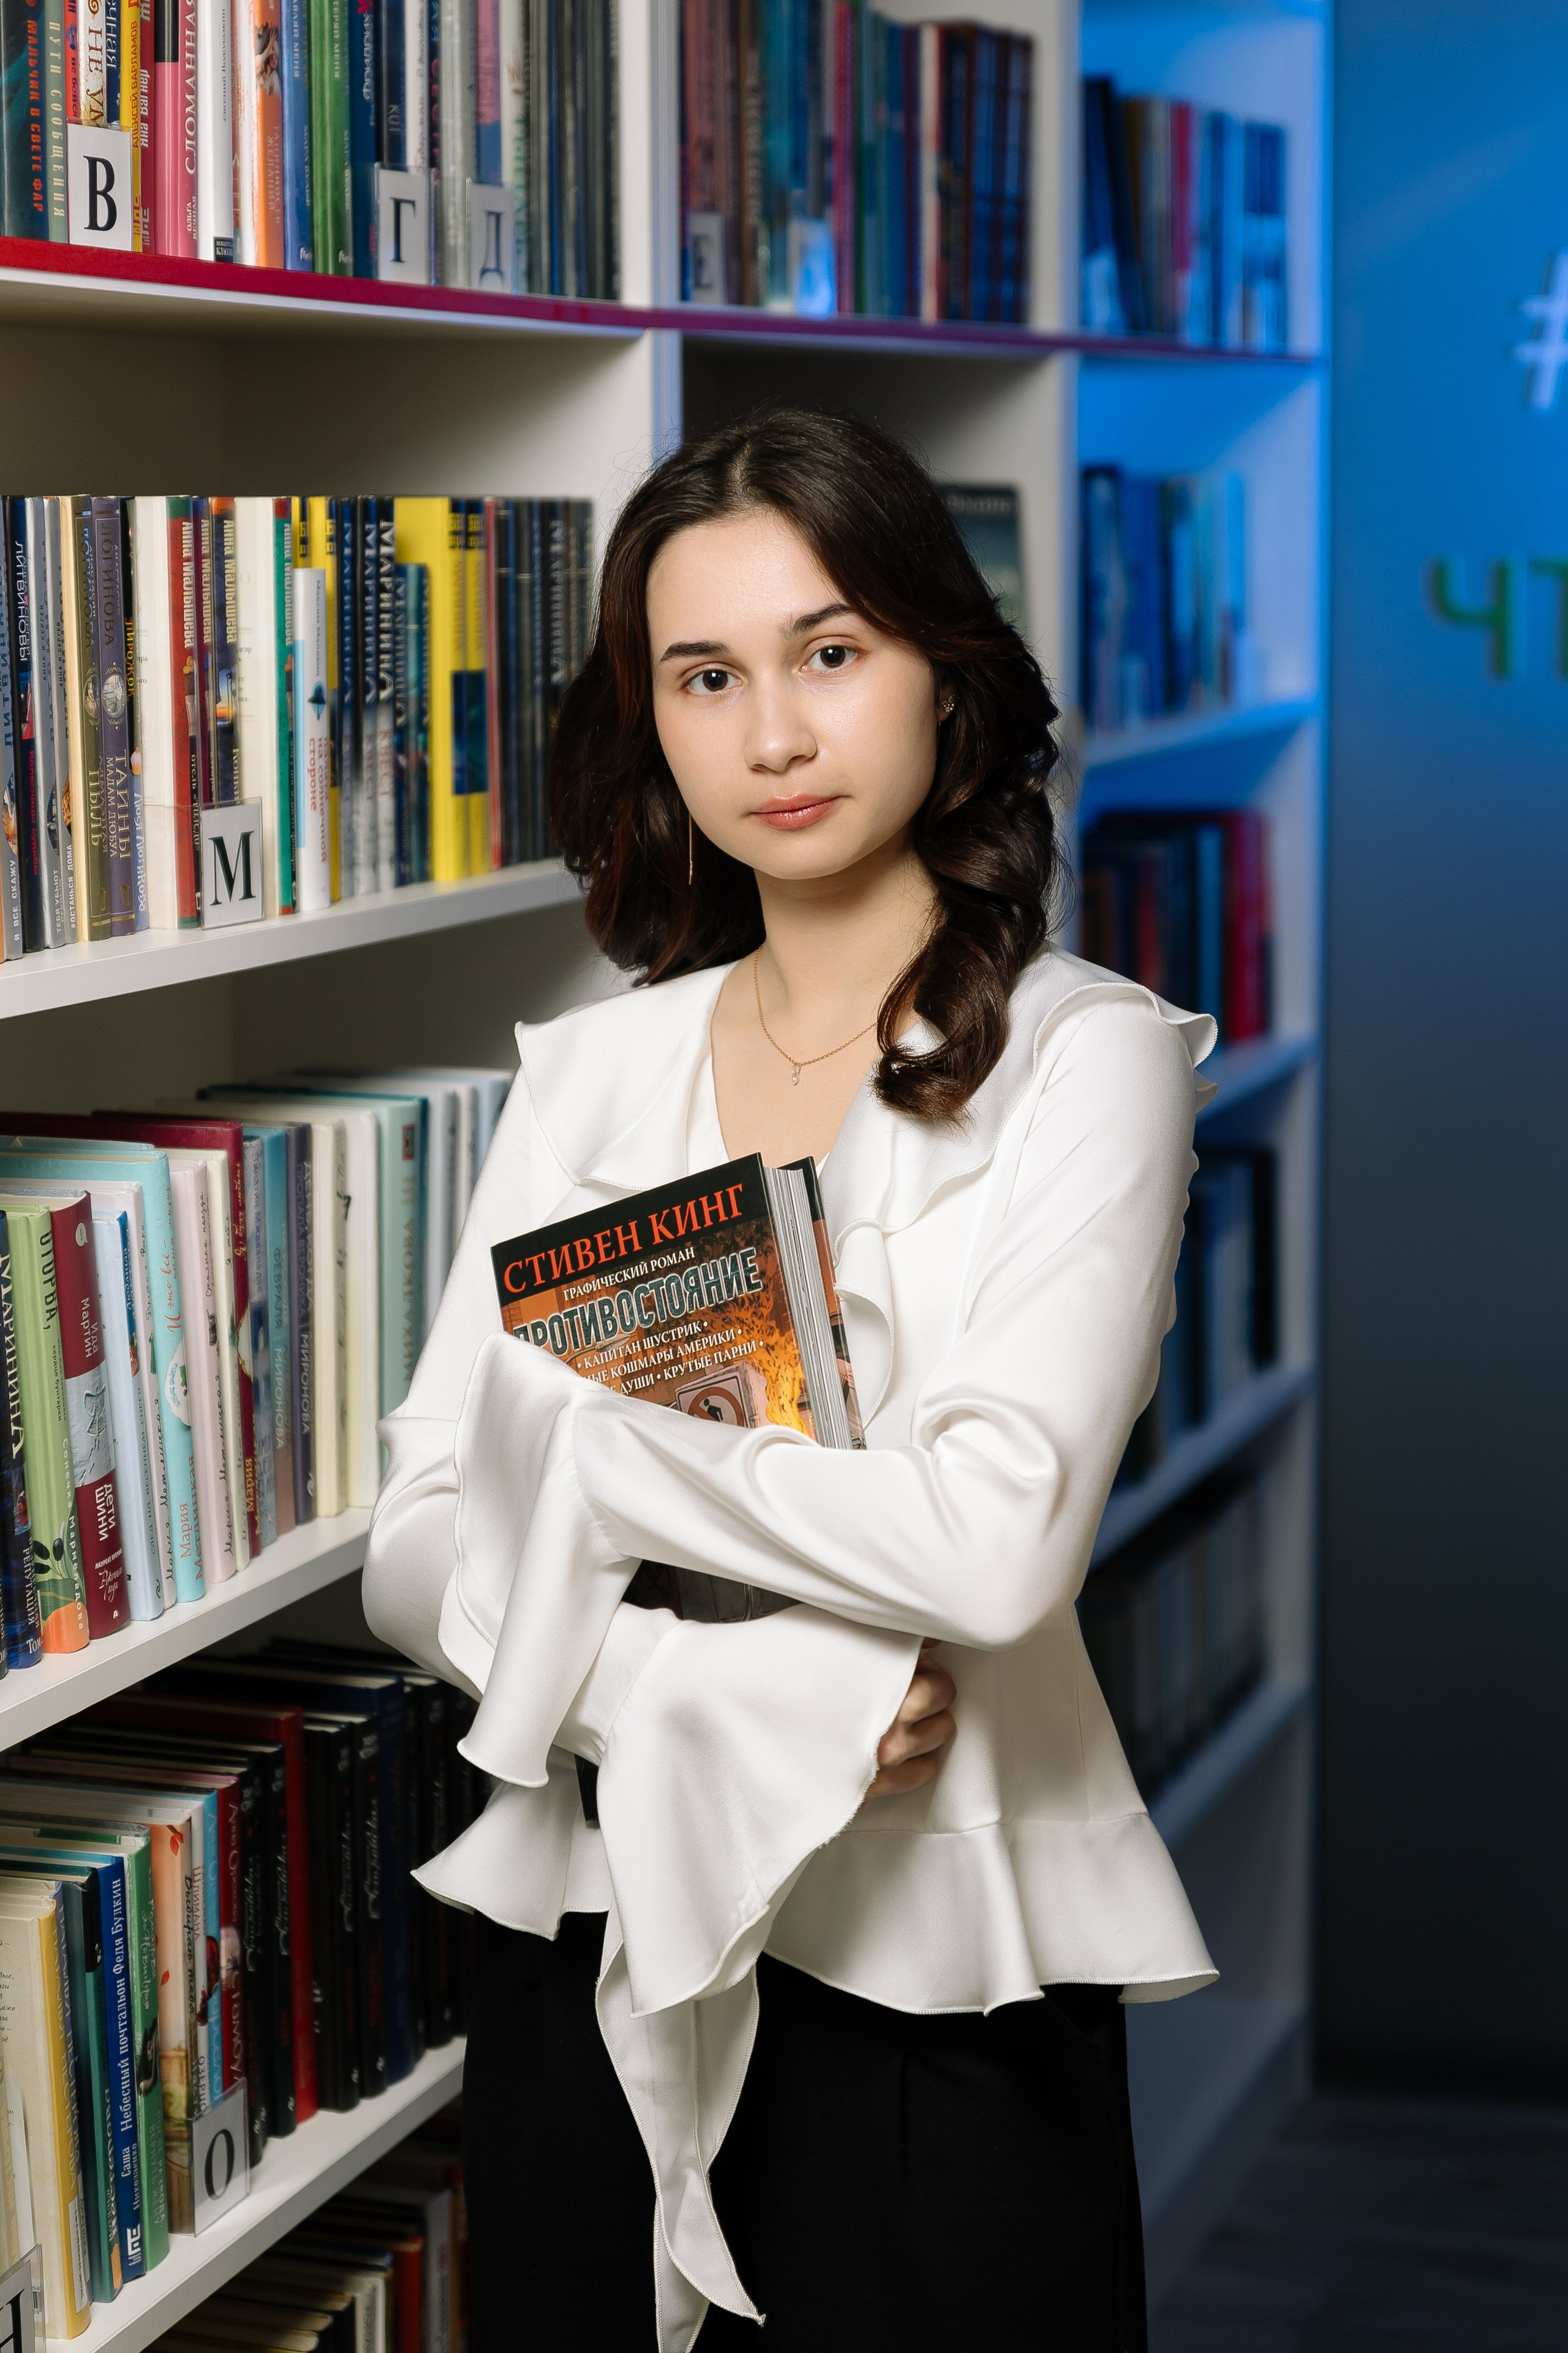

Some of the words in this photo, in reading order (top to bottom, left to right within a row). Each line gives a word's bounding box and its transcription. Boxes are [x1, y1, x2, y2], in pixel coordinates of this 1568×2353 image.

[27, 19, 40, 101] МАЛЬЧИК
[48, 21, 62, 74] ПУТИ
[88, 26, 104, 74] НЕ
[31, 107, 41, 117] В
[129, 94, 139, 148] АЛЕКСЕЙ
[140, 69, 151, 116] Вагнер
[31, 123, 42, 172] СВЕТЕ
[50, 89, 66, 217] СООБЩЕНИЯ
[32, 178, 43, 212] ФАР
[83, 156, 117, 232] В
[390, 197, 416, 263] Г
[479, 210, 503, 290] Д
[182, 521, 194, 558] Анна
[201, 519, 210, 555] Анна
[224, 519, 235, 556] Анна
[15, 540, 28, 661] ЛИТВИНОВЫ
[101, 523, 116, 648] ЛОГИНОВА
[183, 561, 195, 649] Малышева
[202, 557, 212, 644] Малышева
[224, 558, 237, 644] Малышева
[364, 523, 377, 704] МАРИНИНА
[379, 519, 394, 702] МАРИНИНА
[106, 757, 115, 807] МАДАМ
[307, 737, 317, 811] стороне
[88, 769, 102, 846] ПЫЛЬ
[108, 810, 117, 858] ДЮБУА
[134, 792, 143, 831] Люся
[136, 835, 146, 912] Лютикова
[208, 830, 256, 907] М
[13, 933, 20, 942] Я
[200, 1192, 209, 1233] поезда
[503, 1220, 643, 1294] СТИВЕН
[648, 1183, 743, 1245] КИНГ
[203, 1239, 213, 1297] Стоянка
[273, 1247, 283, 1328] ФЕВРАЛЯ
[563, 1260, 649, 1302] ГРАФИЧЕСКИЙ
[650, 1246, 695, 1272] РОМАН
[0, 1252, 24, 1460] МАРИНИНА
[81, 1297, 92, 1358] Мартин
[583, 1341, 642, 1369] КАПИТАН
[642, 1320, 702, 1351] ШУСТРИК
[611, 1348, 674, 1379] КОШМАРЫ
[676, 1328, 736, 1358] АМЕРИКИ
[274, 1347, 285, 1450] МИРОНОВА
[300, 1334, 311, 1434] МИРОНОВА
[620, 1372, 655, 1397] ДУШИ
[663, 1354, 712, 1381] КРУТЫЕ
[713, 1340, 757, 1365] ПАРНИ
[244, 1457, 254, 1512] Мария
[62, 1438, 73, 1509] Сонечка
[69, 1515, 85, 1631] Мармеладова
[165, 1521, 175, 1581] Мария
[179, 1502, 193, 1560] Мария
[224, 1496, 234, 1557] Мария
[23, 1547, 35, 1625] РЕПУТАЦИЯ
[95, 1557, 111, 1569] ЛАУРЕАТ
[111, 1878, 124, 1935] Булкин
[184, 1876, 195, 1963] Выбираю
[192, 1866, 202, 1941] ШЛИМАНА
[113, 1936, 125, 1974] Федя
[116, 1977, 129, 2055] почтальон
[187, 1968, 196, 2018] тебя
[51, 1927, 66, 2040] НАТАЛЬЯ
[61, 2053, 77, 2191] НЕСТЕРОВА
[118, 2057, 133, 2132] Небесный
[121, 2146, 132, 2178] Саша
[130, 2142, 141, 2211] Николаенко
[204, 2128, 235, 2201] О
